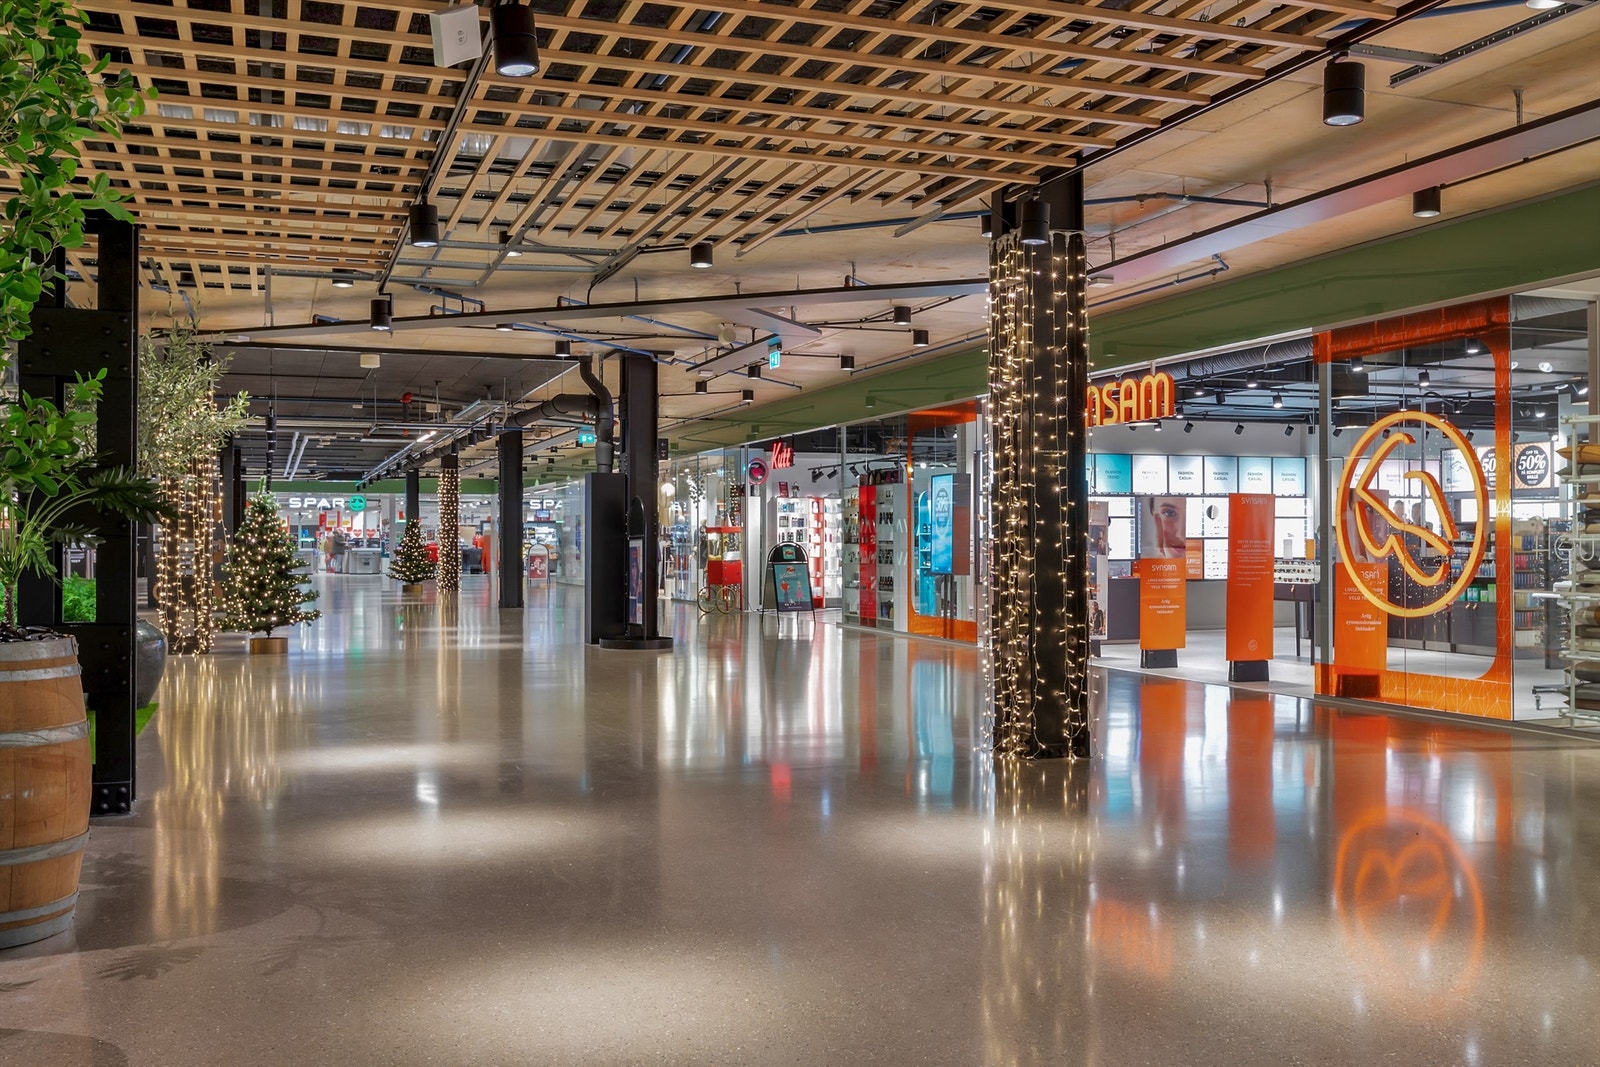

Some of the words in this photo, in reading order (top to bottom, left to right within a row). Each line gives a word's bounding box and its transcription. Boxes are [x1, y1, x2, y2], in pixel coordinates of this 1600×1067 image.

[1085, 372, 1174, 428] NSAM
[771, 442, 792, 469] Kutt
[1518, 454, 1546, 470] 50%
[1482, 458, 1496, 472] 50
[289, 497, 345, 508] SPAR
[529, 499, 563, 509] SPA
[1152, 564, 1177, 572] SYNSAM
